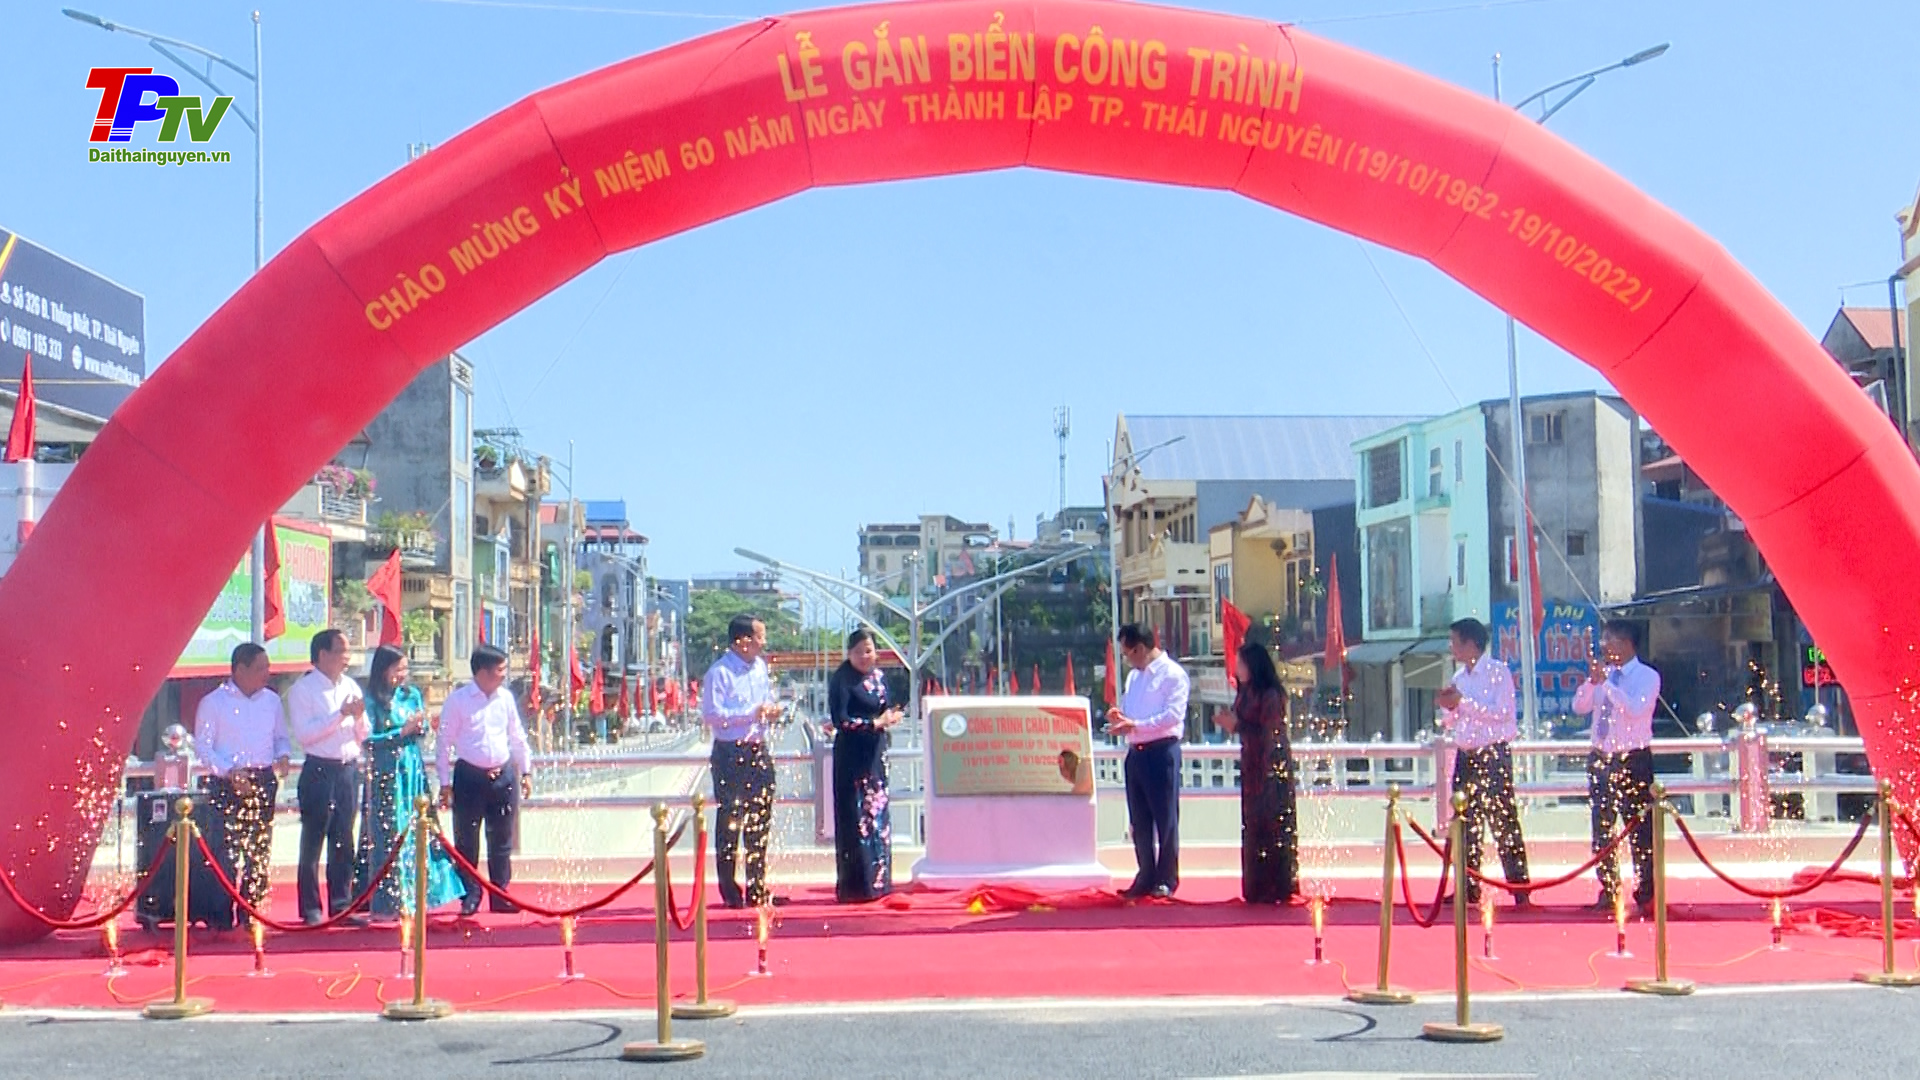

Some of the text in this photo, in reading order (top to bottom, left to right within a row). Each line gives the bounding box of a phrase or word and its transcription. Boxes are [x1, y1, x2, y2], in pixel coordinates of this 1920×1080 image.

[777, 11, 1305, 115] LỄ GẮN BIỂN CÔNG TRÌNH
[364, 262, 447, 332] CHÀO
[448, 206, 541, 276] MỪNG
[543, 166, 585, 220] KỶ
[593, 148, 672, 198] NIỆM
[679, 137, 715, 171] 60
[723, 115, 796, 160] NĂM
[805, 96, 887, 139] NGÀY
[901, 84, 1005, 125] THÀNH
[1016, 84, 1074, 126] LẬP
[1087, 95, 1132, 127] TP.
[1141, 100, 1209, 138] THÁI
[1217, 113, 1342, 167] NGUYÊN
[12, 285, 24, 310] Số
